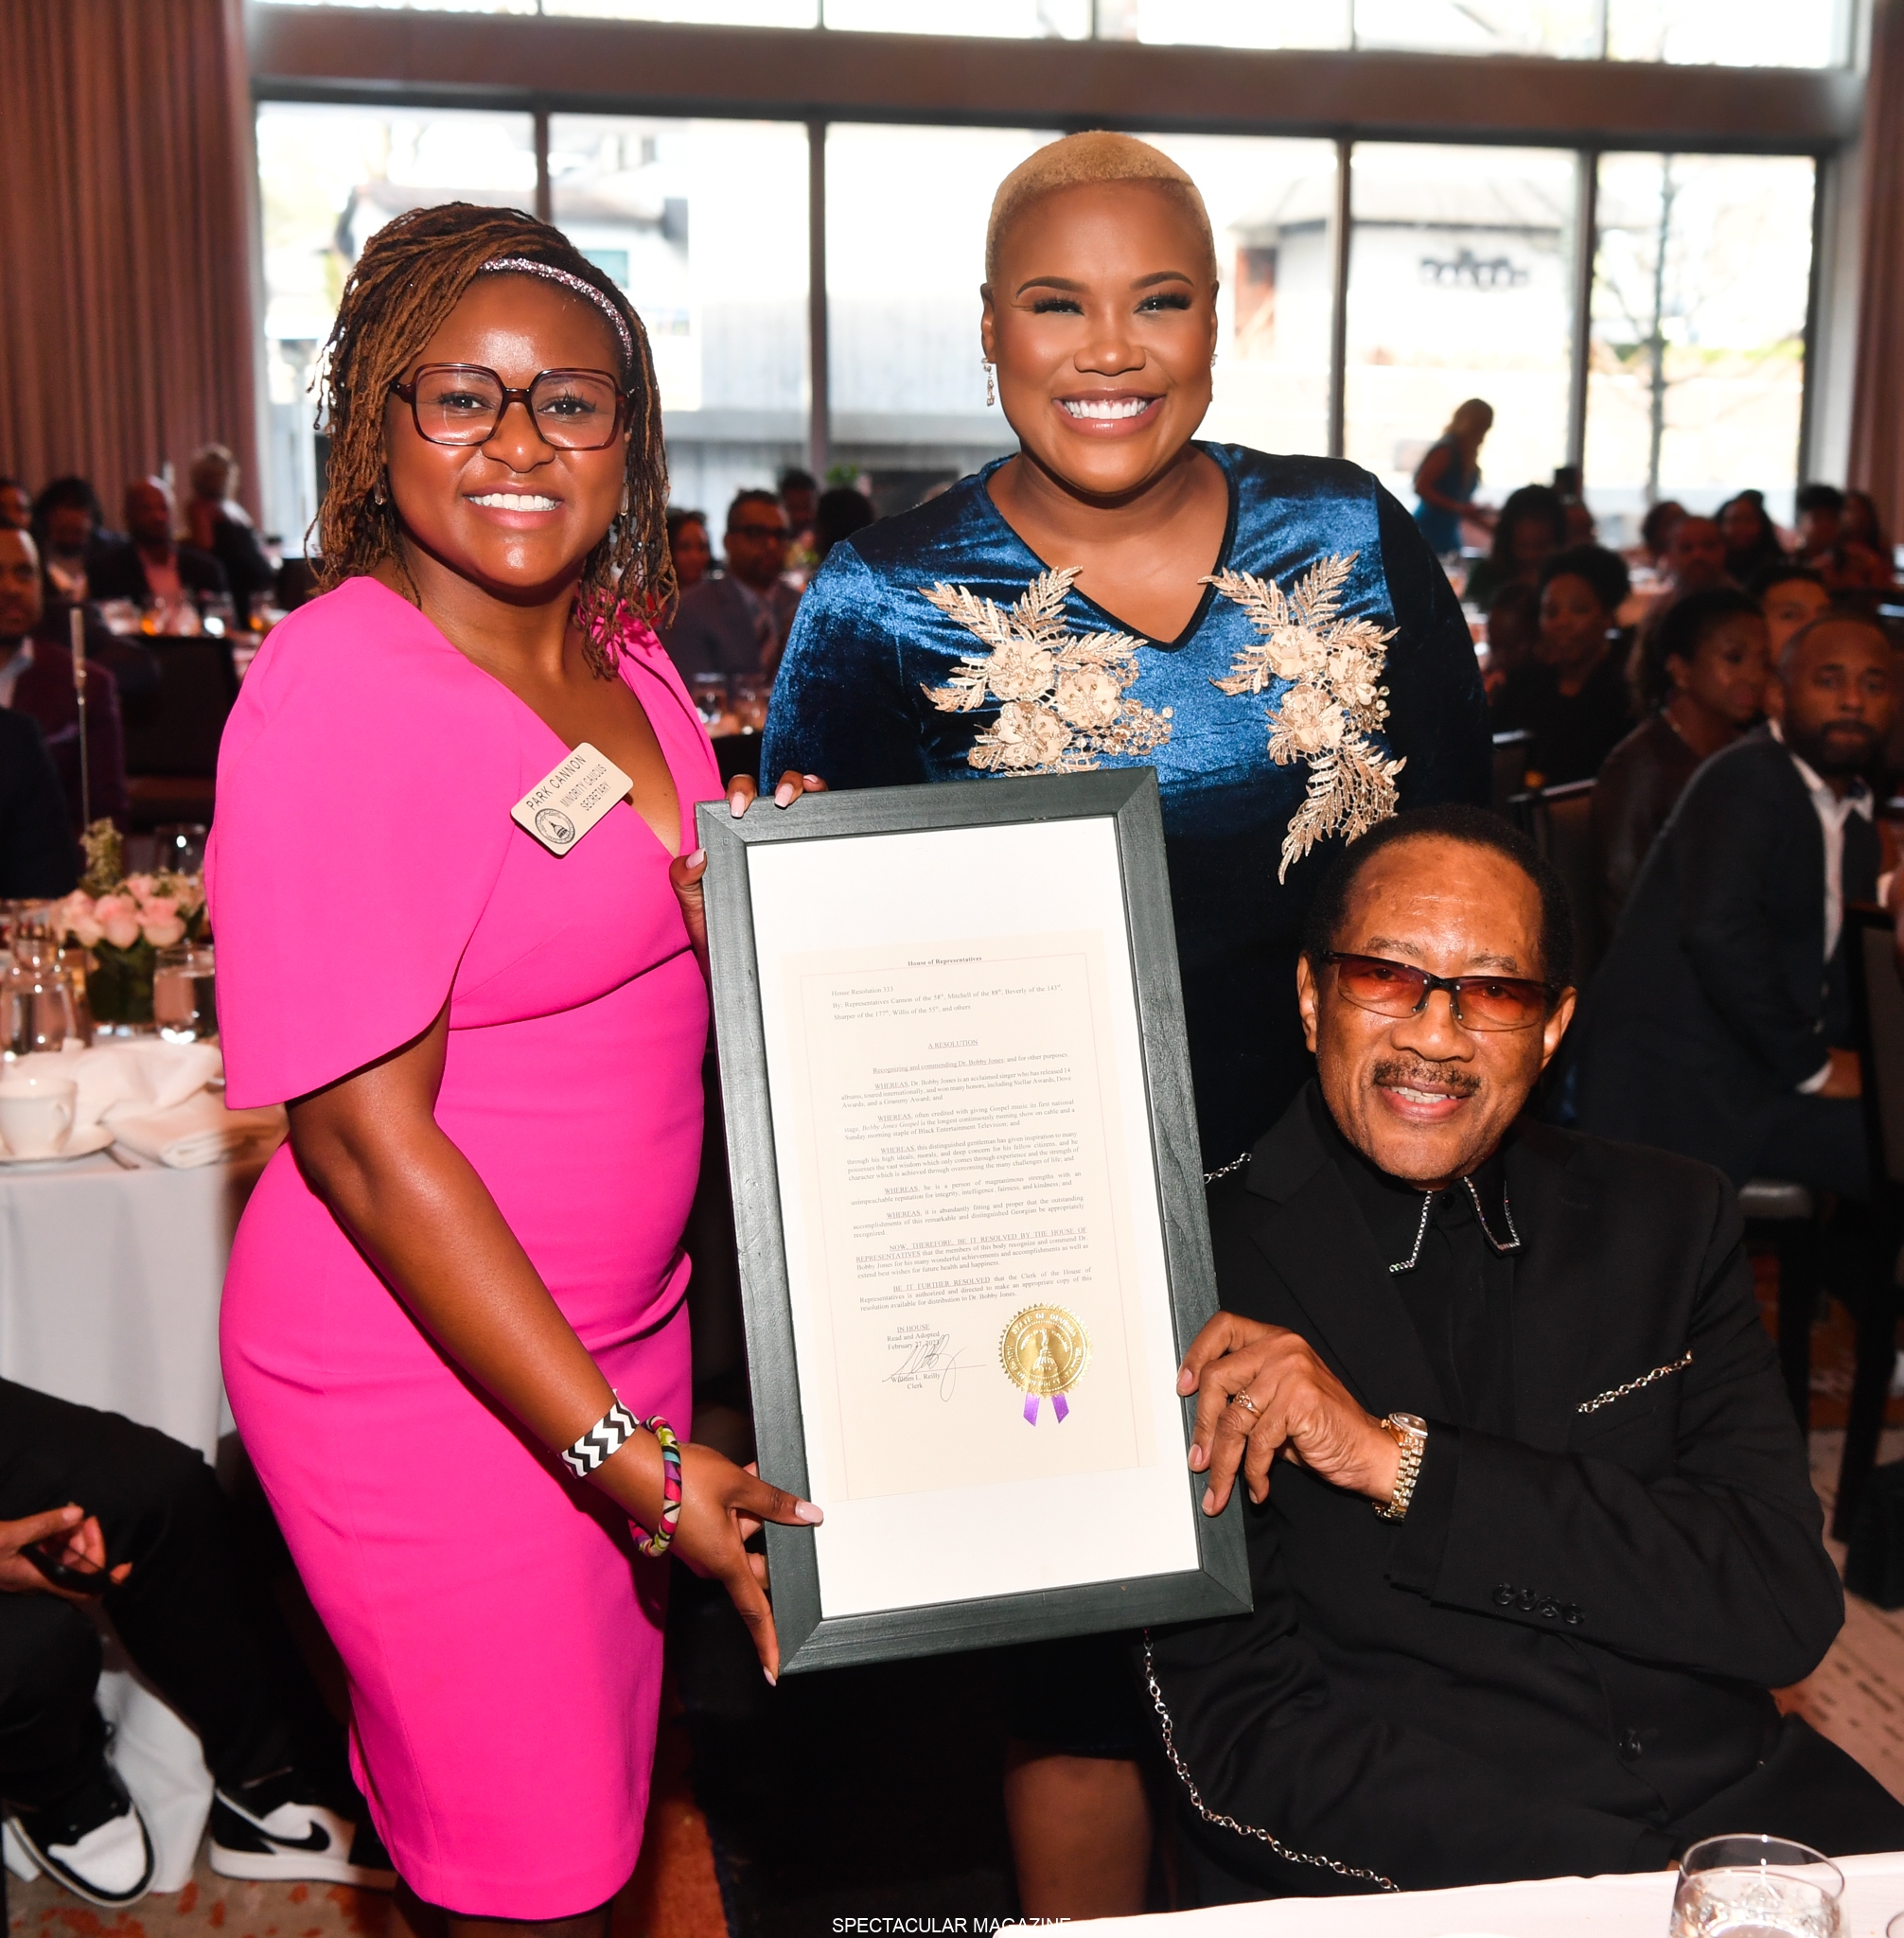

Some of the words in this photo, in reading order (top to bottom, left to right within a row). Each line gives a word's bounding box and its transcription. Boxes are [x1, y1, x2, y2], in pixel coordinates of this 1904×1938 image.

[526, 785, 553, 810] PARK
[550, 755, 587, 789] CANNON
[560, 781, 586, 808] MINORITY
[584, 764, 608, 786] CAUCUS
[580, 781, 612, 811] SECRETARY
